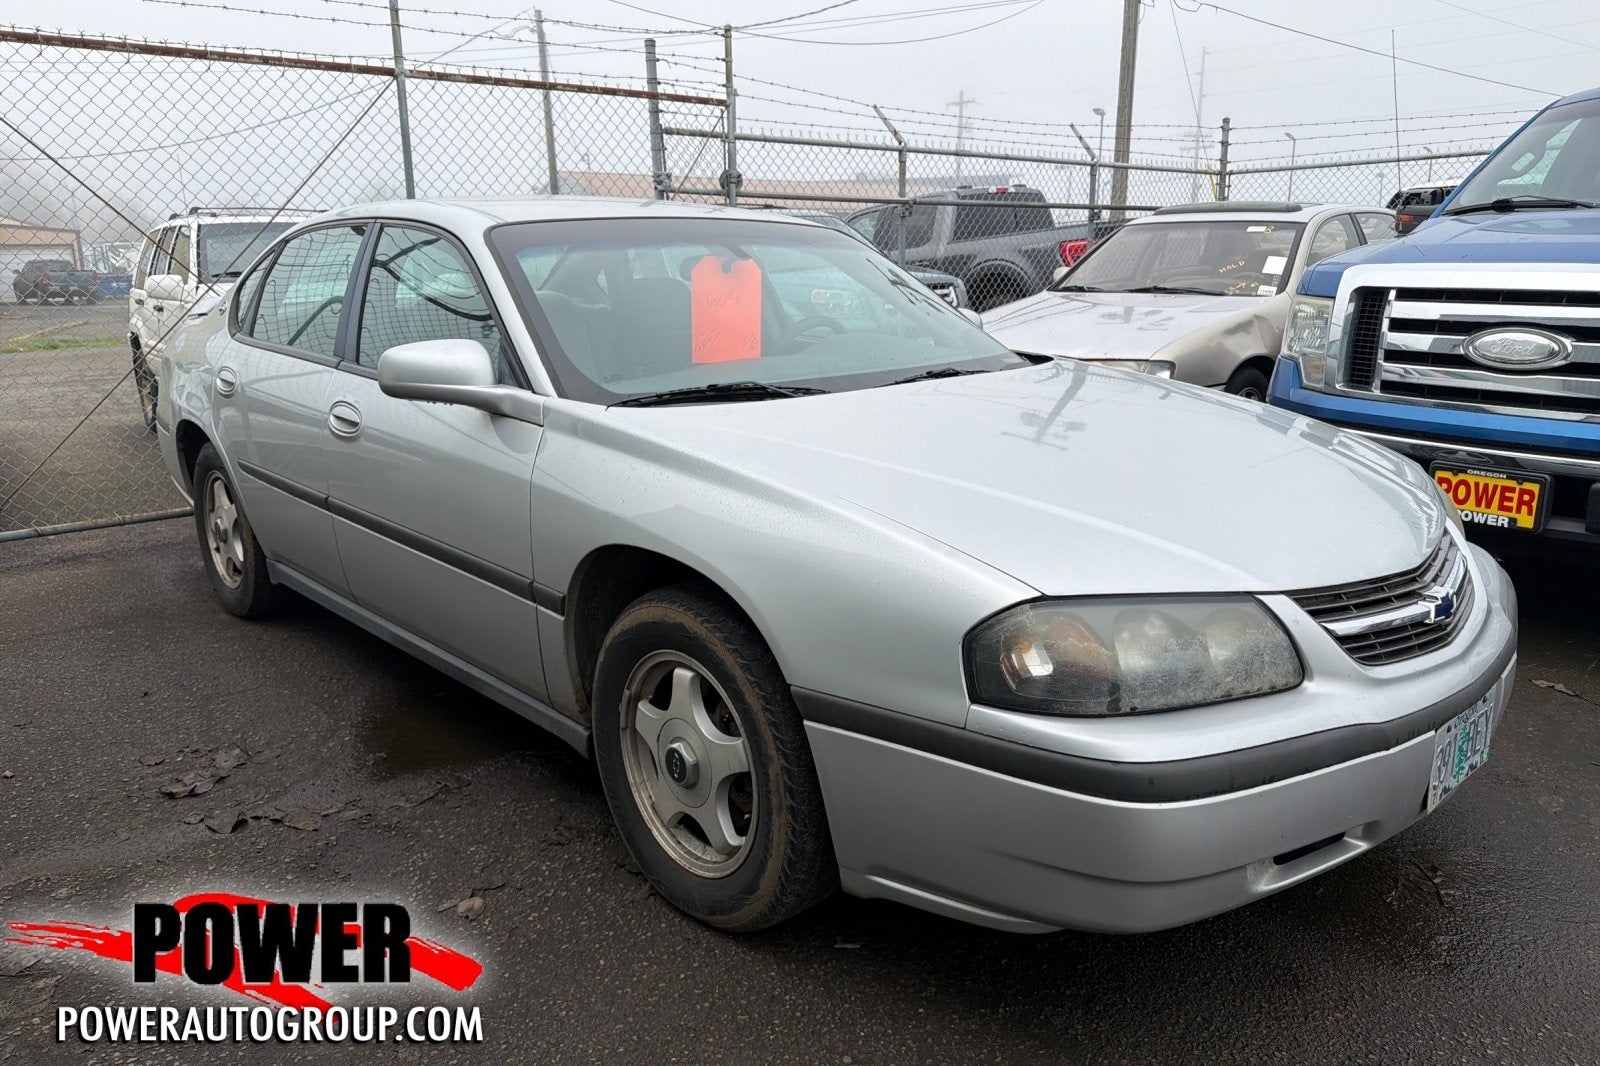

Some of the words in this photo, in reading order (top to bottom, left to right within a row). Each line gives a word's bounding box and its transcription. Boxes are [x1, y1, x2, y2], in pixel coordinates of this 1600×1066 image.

[1490, 338, 1537, 356] Ford
[1466, 469, 1507, 479] OREGON
[1437, 476, 1536, 517] POWER
